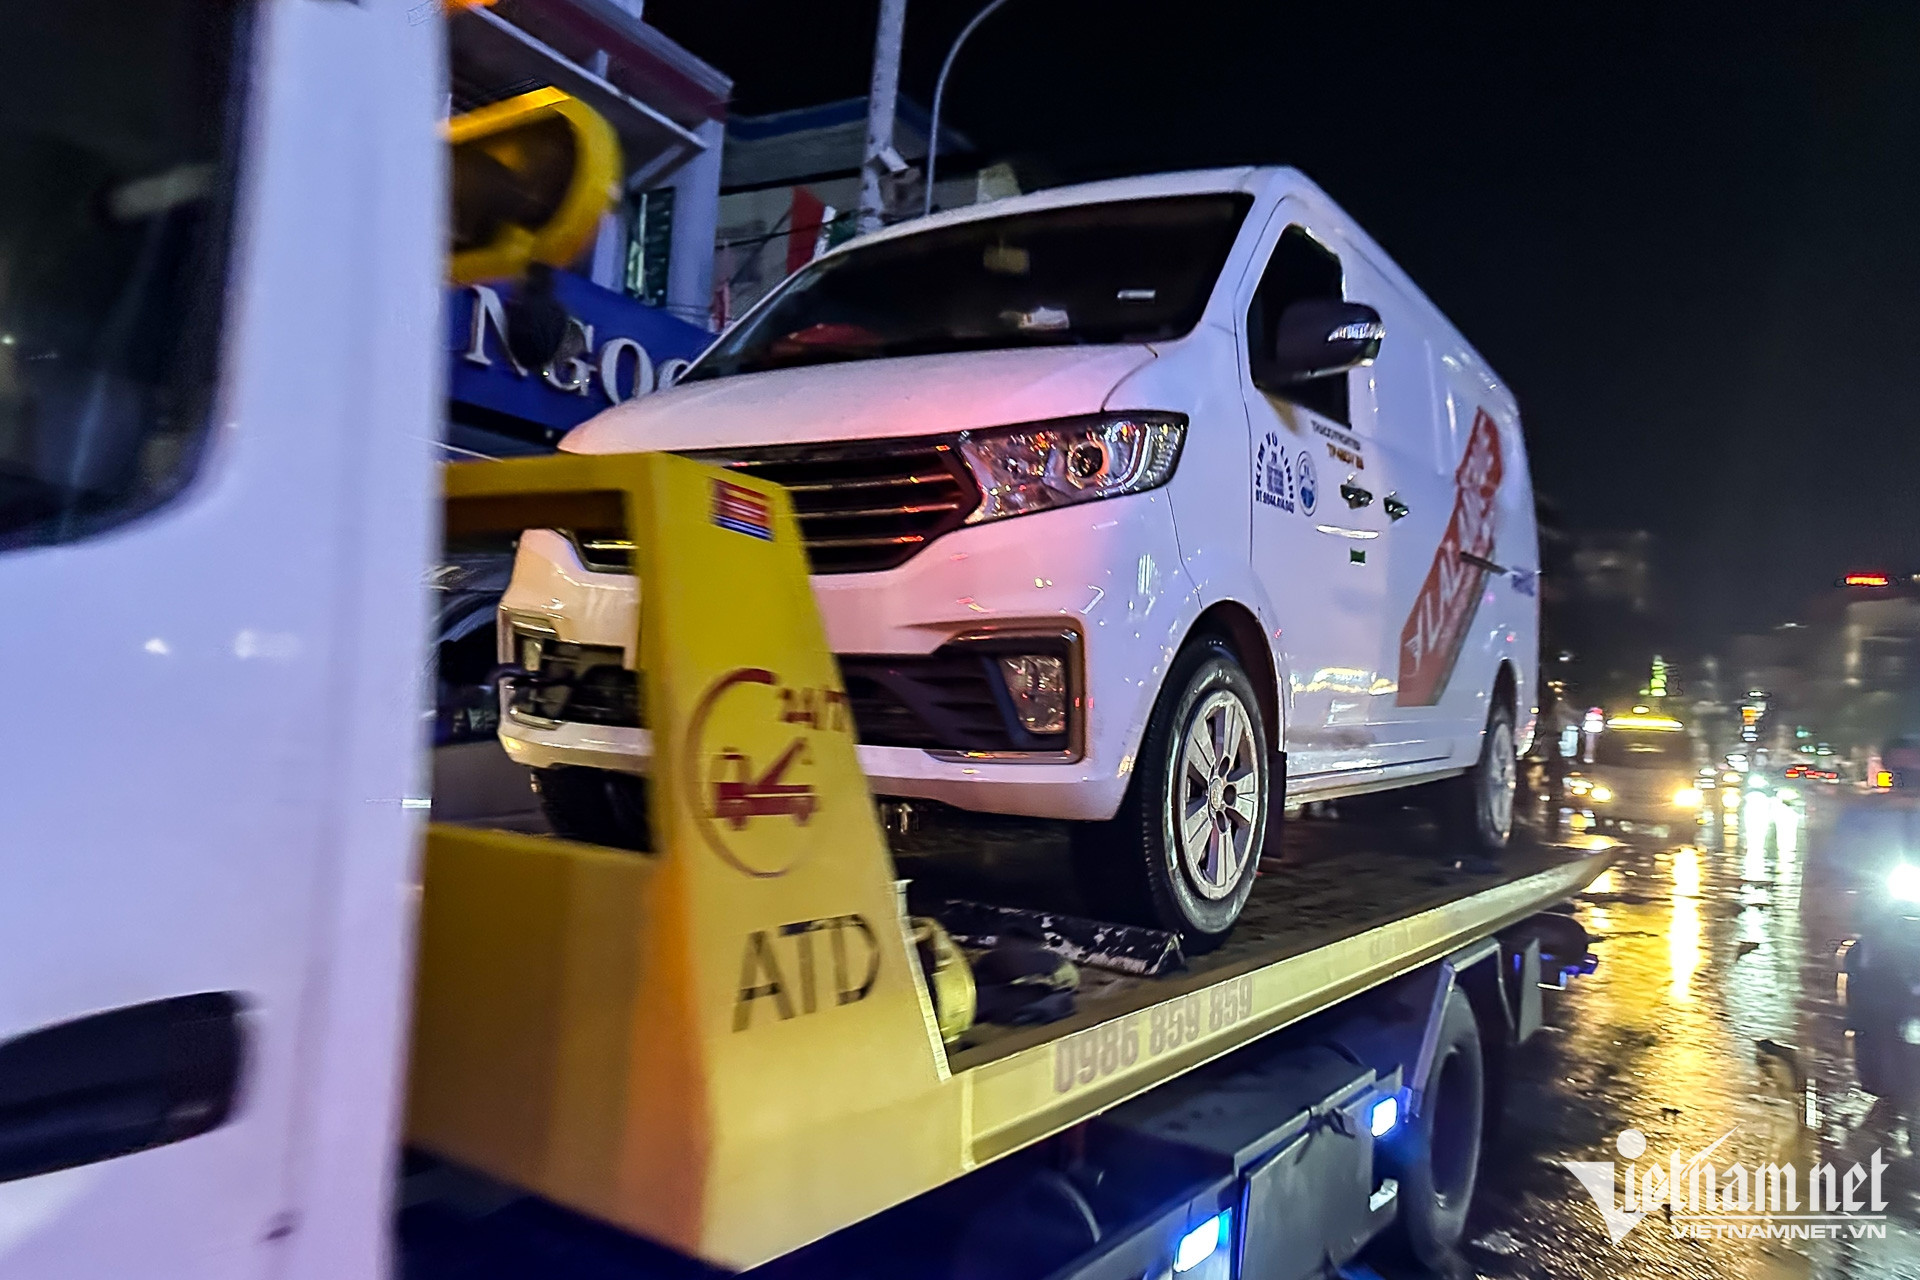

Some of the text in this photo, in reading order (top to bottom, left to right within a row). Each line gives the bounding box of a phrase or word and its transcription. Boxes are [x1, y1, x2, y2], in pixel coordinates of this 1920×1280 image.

[732, 914, 880, 1033] ATD
[1053, 977, 1251, 1093] 0986 859 859
